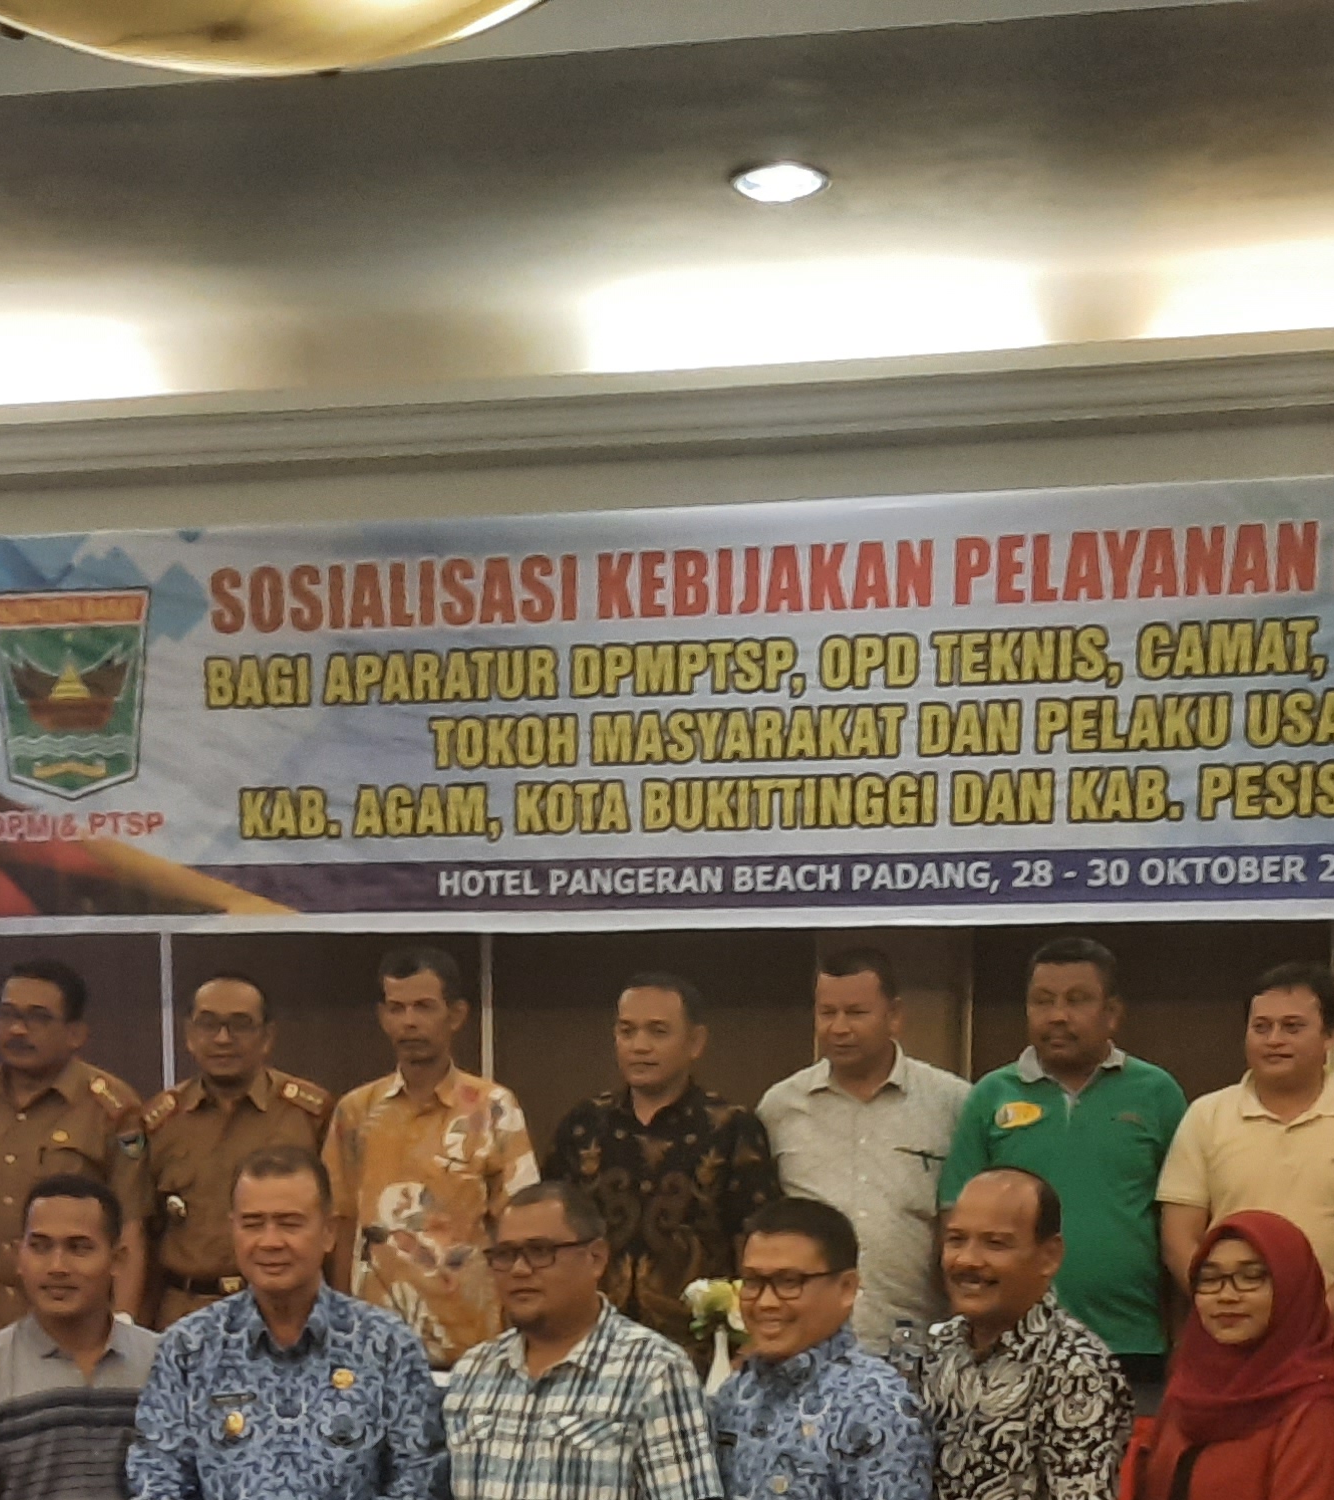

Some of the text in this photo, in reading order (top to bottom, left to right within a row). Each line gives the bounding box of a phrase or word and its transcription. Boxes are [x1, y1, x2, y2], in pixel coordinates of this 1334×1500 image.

[210, 555, 578, 634] SOSIALISASI
[598, 539, 932, 619] KEBIJAKAN
[954, 521, 1318, 605] PELAYANAN
[204, 653, 312, 709] BAGI
[322, 646, 558, 704] APARATUR
[570, 636, 806, 698] DPMPTSP,
[819, 633, 919, 691] OPD
[931, 625, 1123, 688] TEKNIS,
[1136, 617, 1328, 680] CAMAT,
[429, 713, 578, 769] TOKOH
[591, 703, 907, 765] MASYARAKAT
[918, 699, 1022, 757] DAN
[1034, 691, 1232, 753] PELAKU
[88, 811, 164, 836] PTSP
[239, 785, 342, 839] KAB.
[352, 782, 503, 842] AGAM,
[515, 779, 630, 834] KOTA
[642, 772, 937, 832] BUKITTINGGI
[950, 768, 1054, 825] DAN
[1068, 764, 1184, 824] KAB.
[438, 869, 540, 897] HOTEL
[548, 866, 723, 896] PANGERAN
[733, 863, 841, 892] BEACH
[851, 860, 1002, 893] PADANG,
[1011, 860, 1053, 887] 28
[1086, 858, 1130, 886] 30
[1140, 855, 1307, 885] OKTOBER
